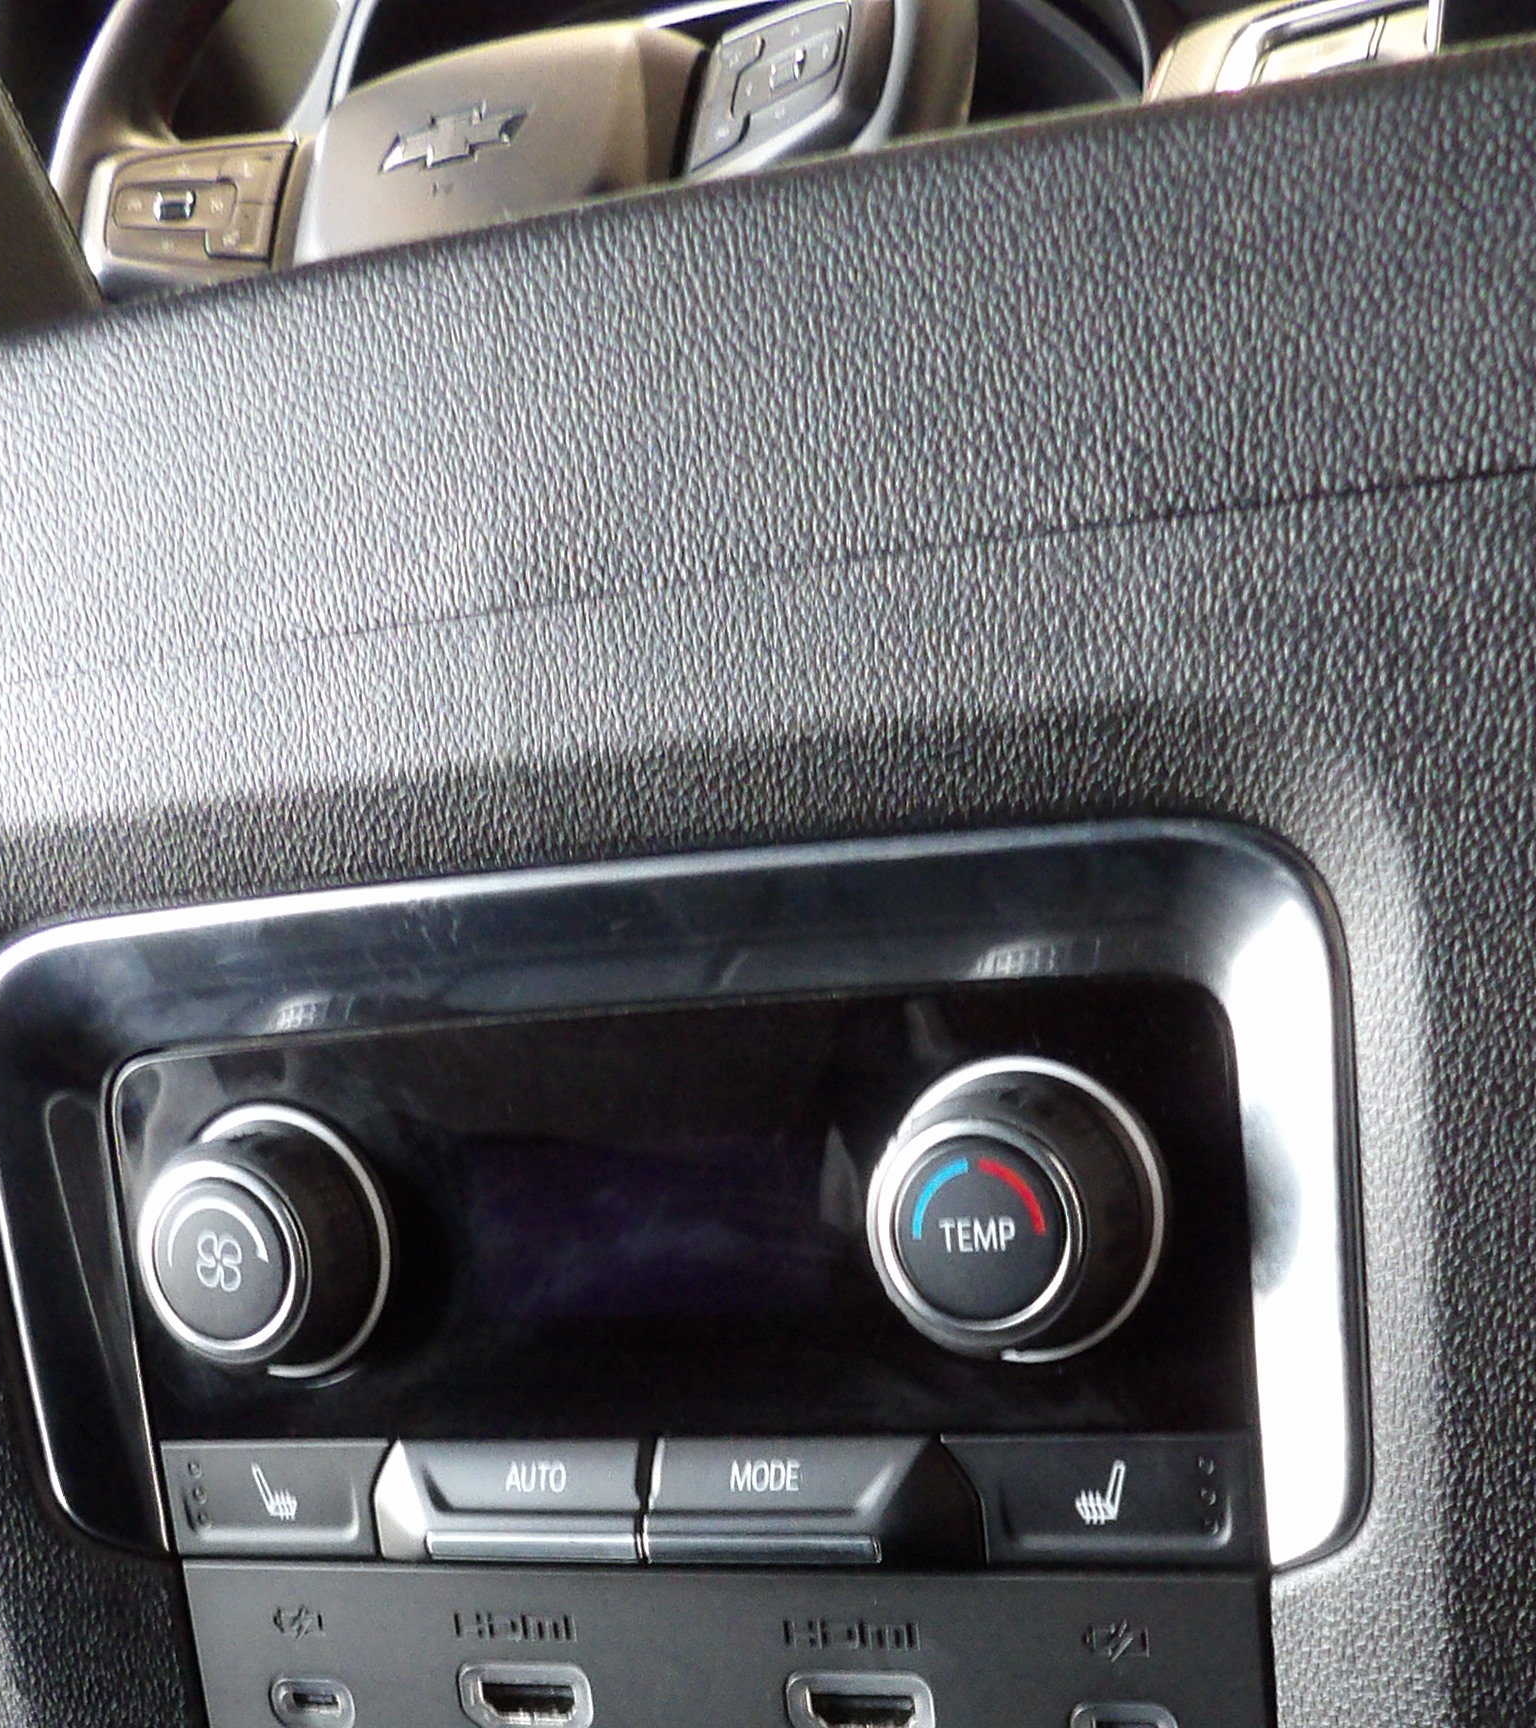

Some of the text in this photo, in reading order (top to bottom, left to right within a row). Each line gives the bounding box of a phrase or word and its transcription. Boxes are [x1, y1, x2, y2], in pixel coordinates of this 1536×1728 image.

[938, 1216, 1016, 1253] TEMP
[505, 1459, 566, 1493] AUTO
[728, 1458, 801, 1493] MODE
